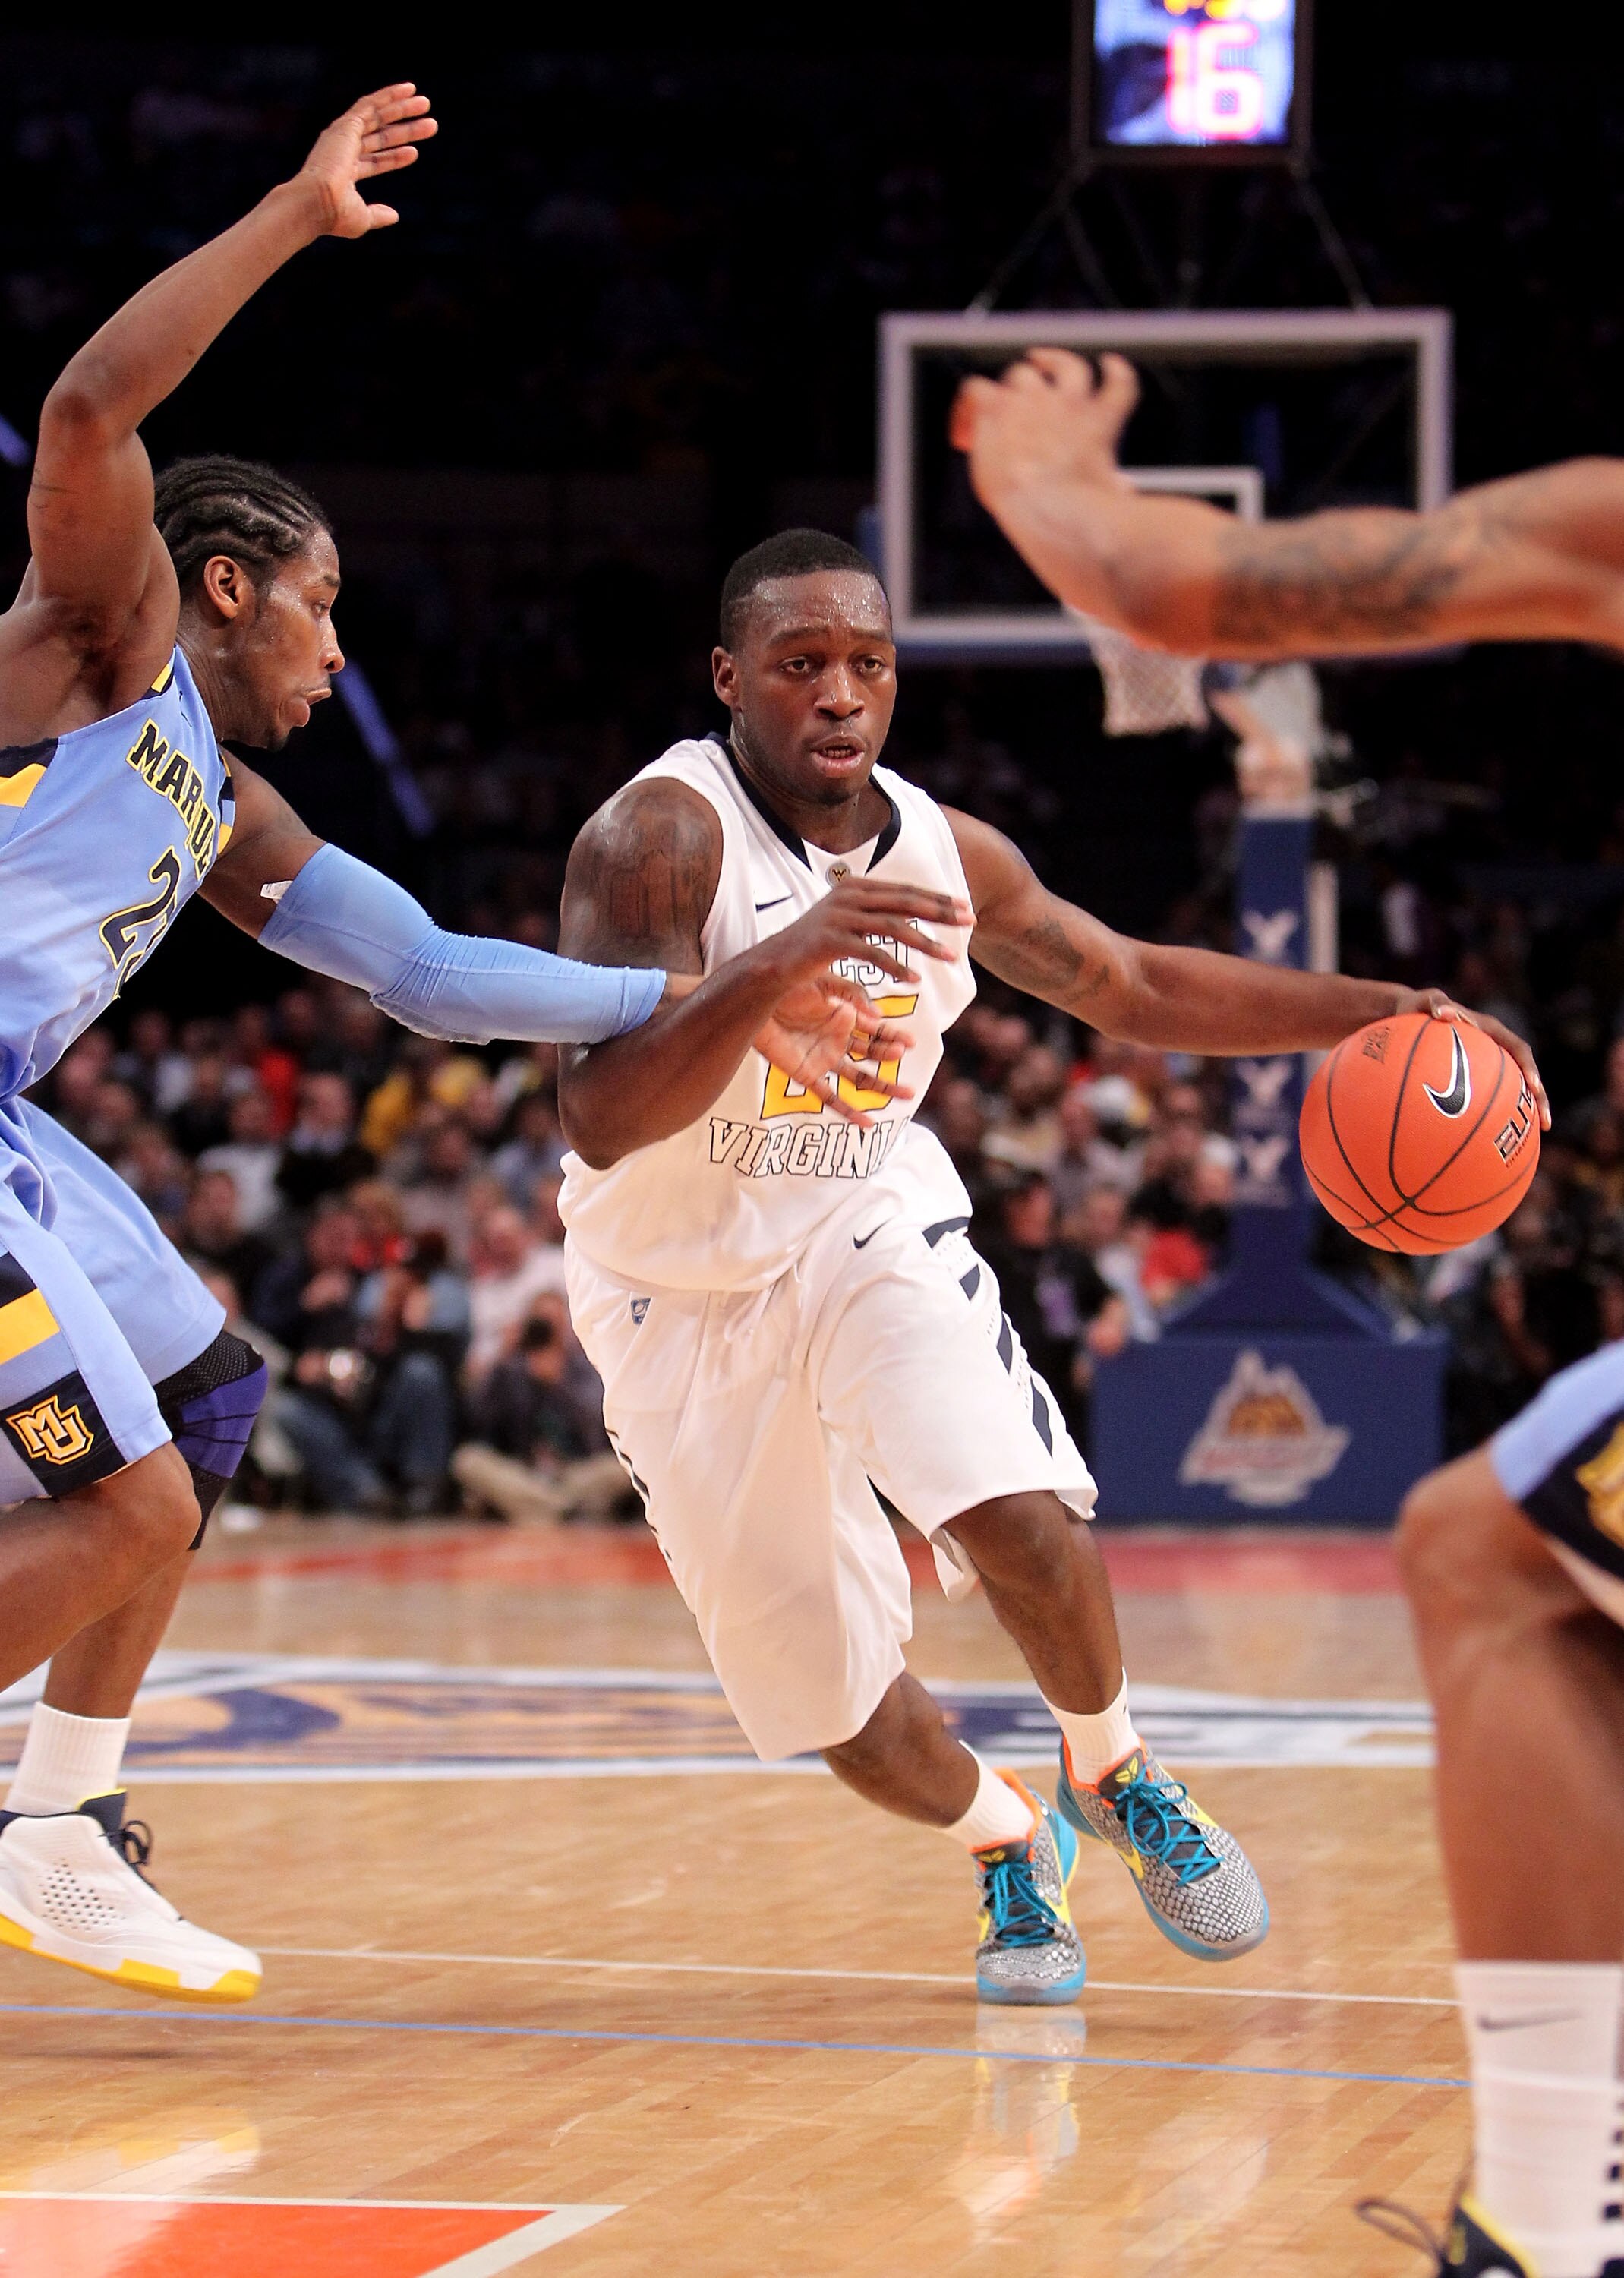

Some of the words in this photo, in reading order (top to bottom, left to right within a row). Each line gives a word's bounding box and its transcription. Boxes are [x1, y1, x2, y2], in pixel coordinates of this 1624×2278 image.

[1167, 21, 1263, 140] 16
[709, 1117, 910, 1178] VIRGINI
[9, 1398, 91, 1463] MU
